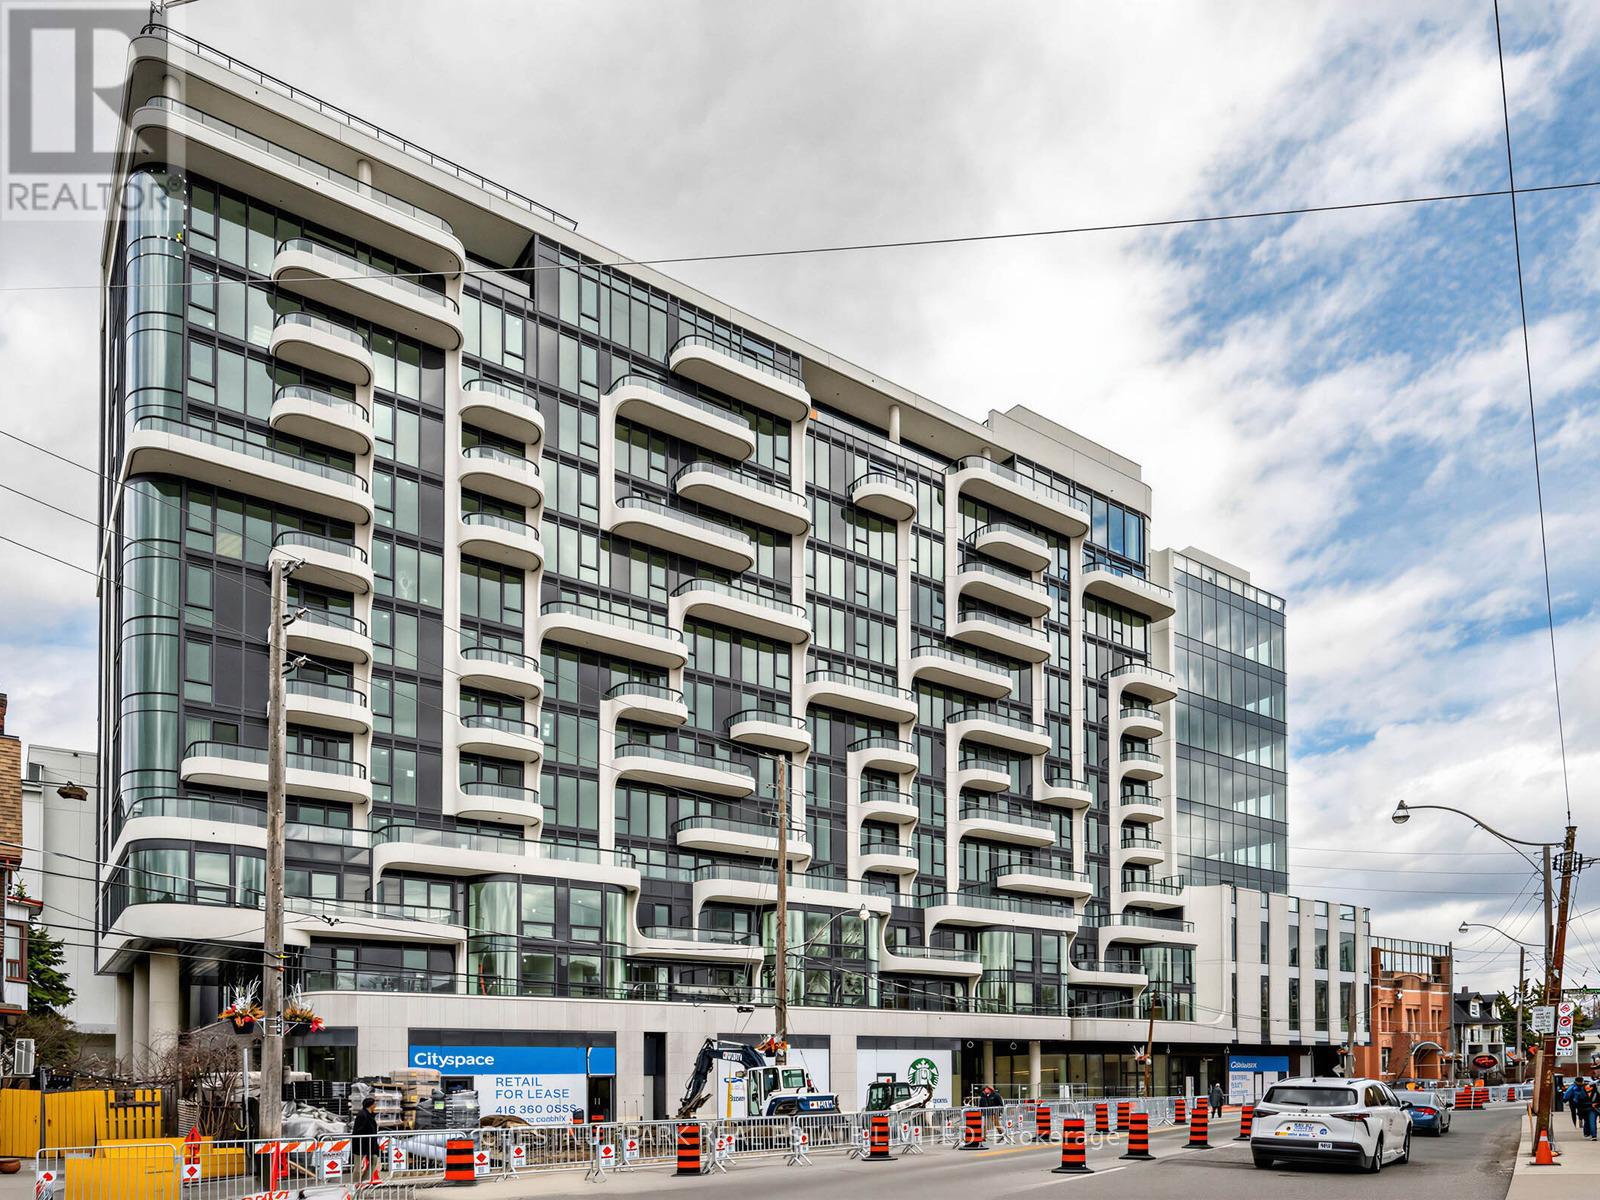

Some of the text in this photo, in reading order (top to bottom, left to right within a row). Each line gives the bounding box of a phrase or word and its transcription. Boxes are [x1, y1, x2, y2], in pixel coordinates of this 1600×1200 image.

[414, 1052, 495, 1068] Cityspace
[495, 1077, 543, 1087] RETAIL
[495, 1088, 570, 1100] FOR LEASE
[495, 1105, 516, 1115] 416
[519, 1104, 543, 1114] 360
